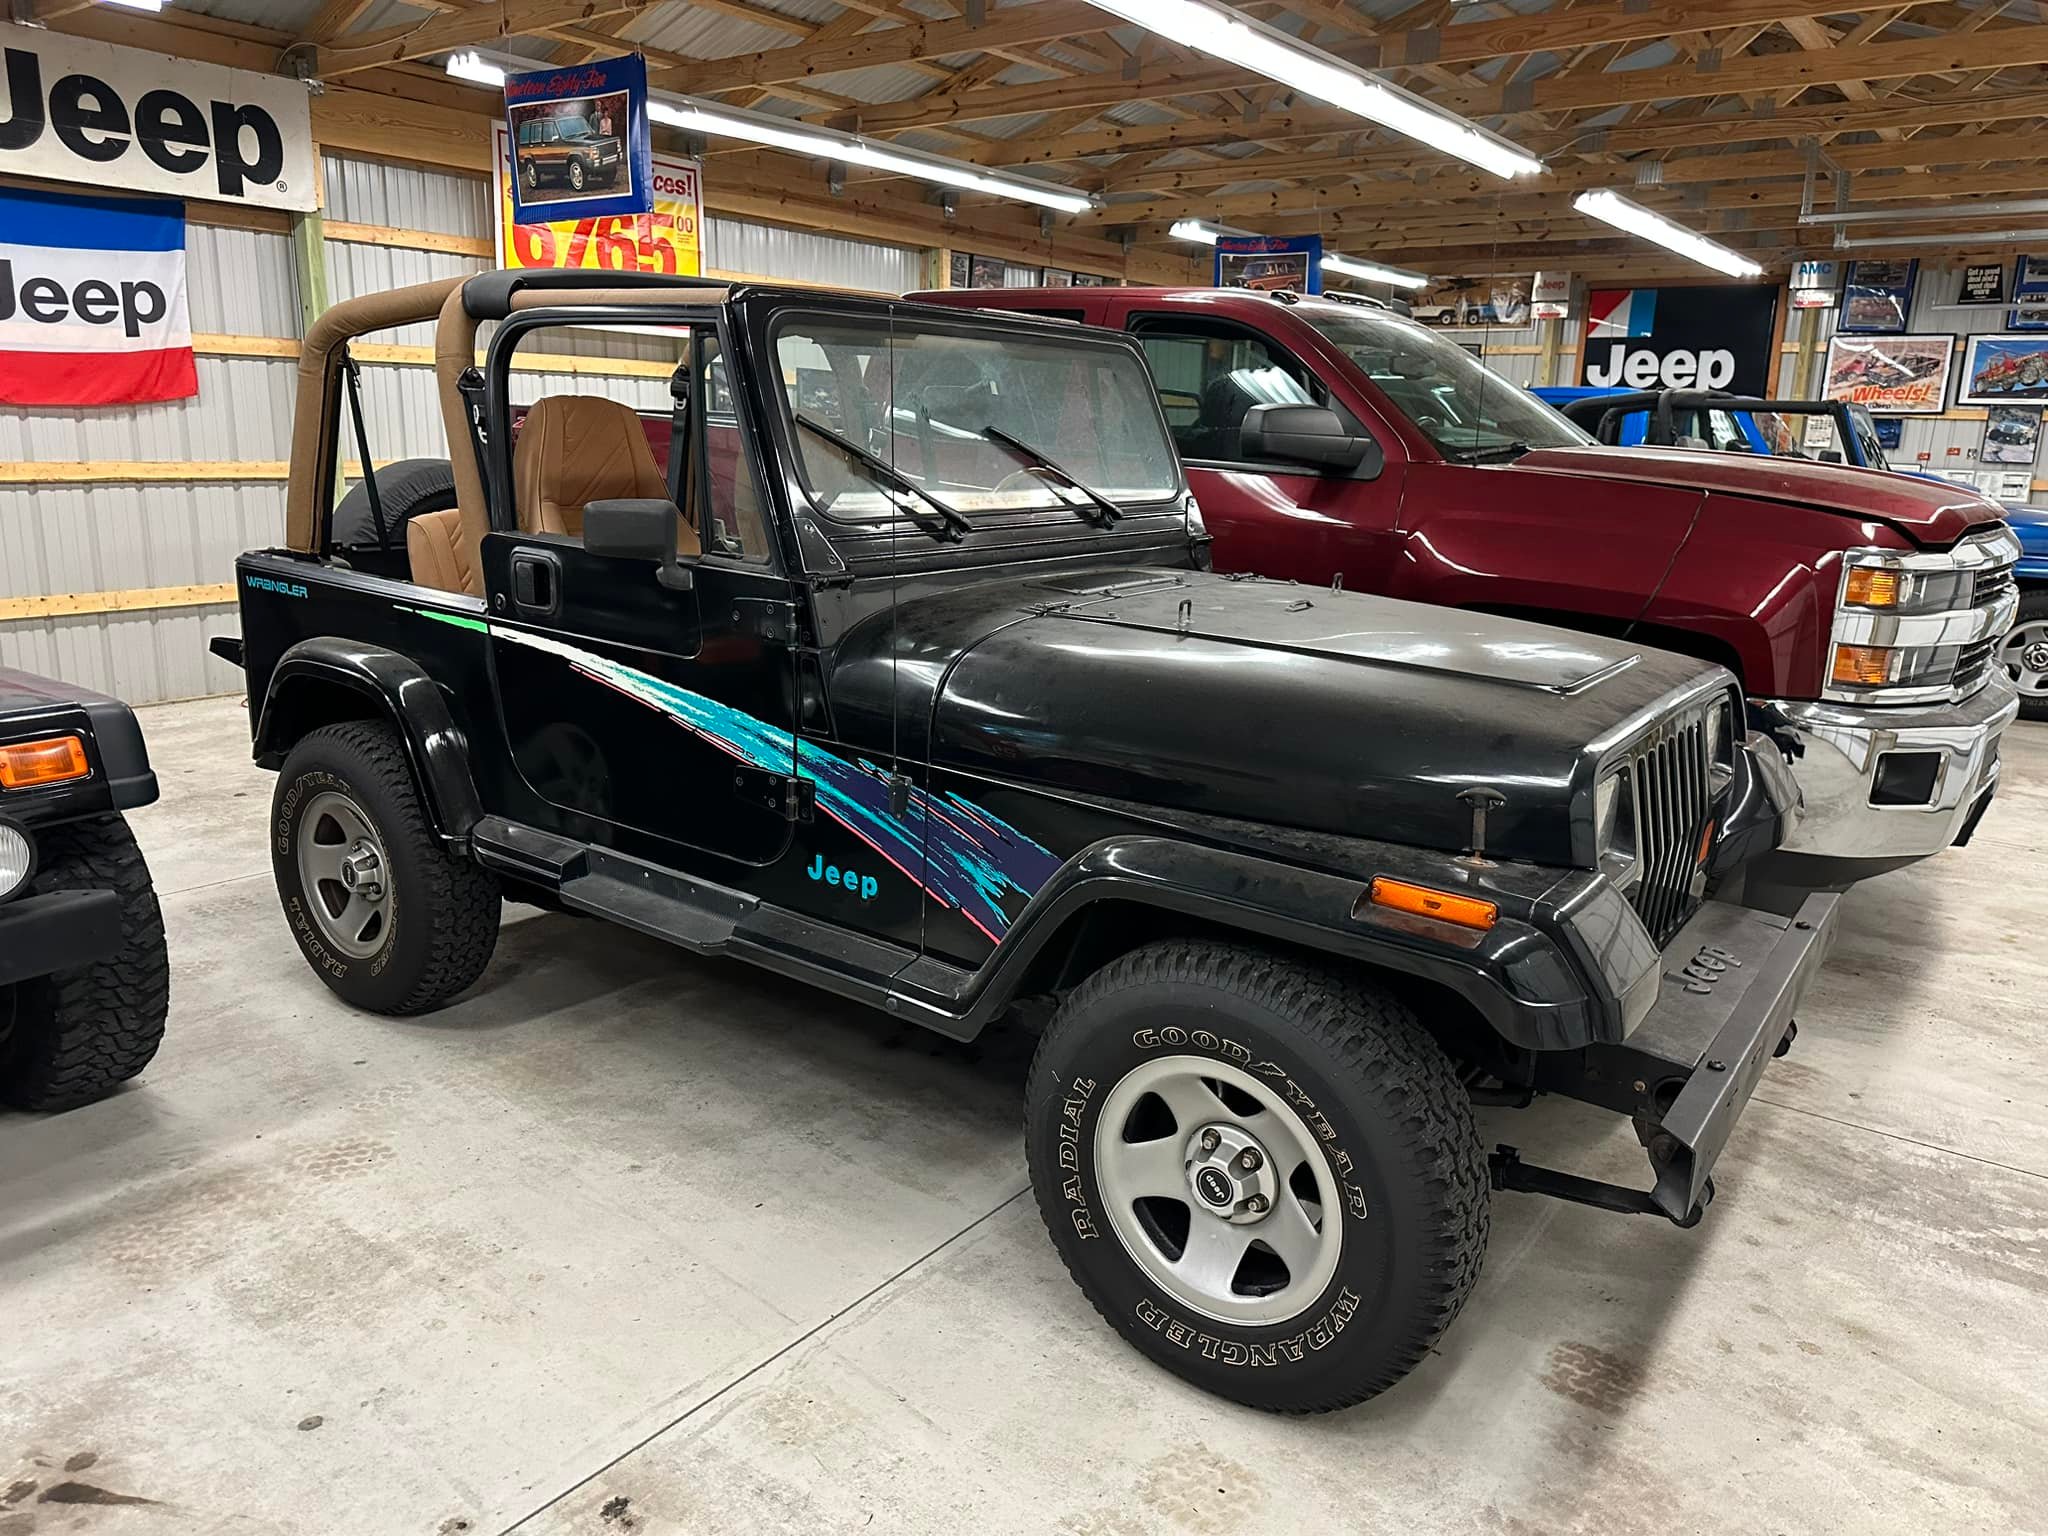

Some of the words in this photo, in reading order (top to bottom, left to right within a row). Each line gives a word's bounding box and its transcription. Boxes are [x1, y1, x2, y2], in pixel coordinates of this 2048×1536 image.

[652, 173, 692, 197] ces!
[1537, 279, 1565, 291] Jeep
[1798, 263, 1832, 275] AMC
[1586, 344, 1735, 390] Jeep
[1853, 384, 1931, 403] Wheels!
[245, 575, 309, 600] WRANGLER
[807, 854, 878, 899] Jeep
[1663, 945, 1742, 995] Jeep
[1133, 1026, 1368, 1220] GOODYEAR
[1059, 1077, 1099, 1240] RADIAL
[1206, 1175, 1225, 1199] Jeep
[1135, 1286, 1363, 1367] WRANGLER
